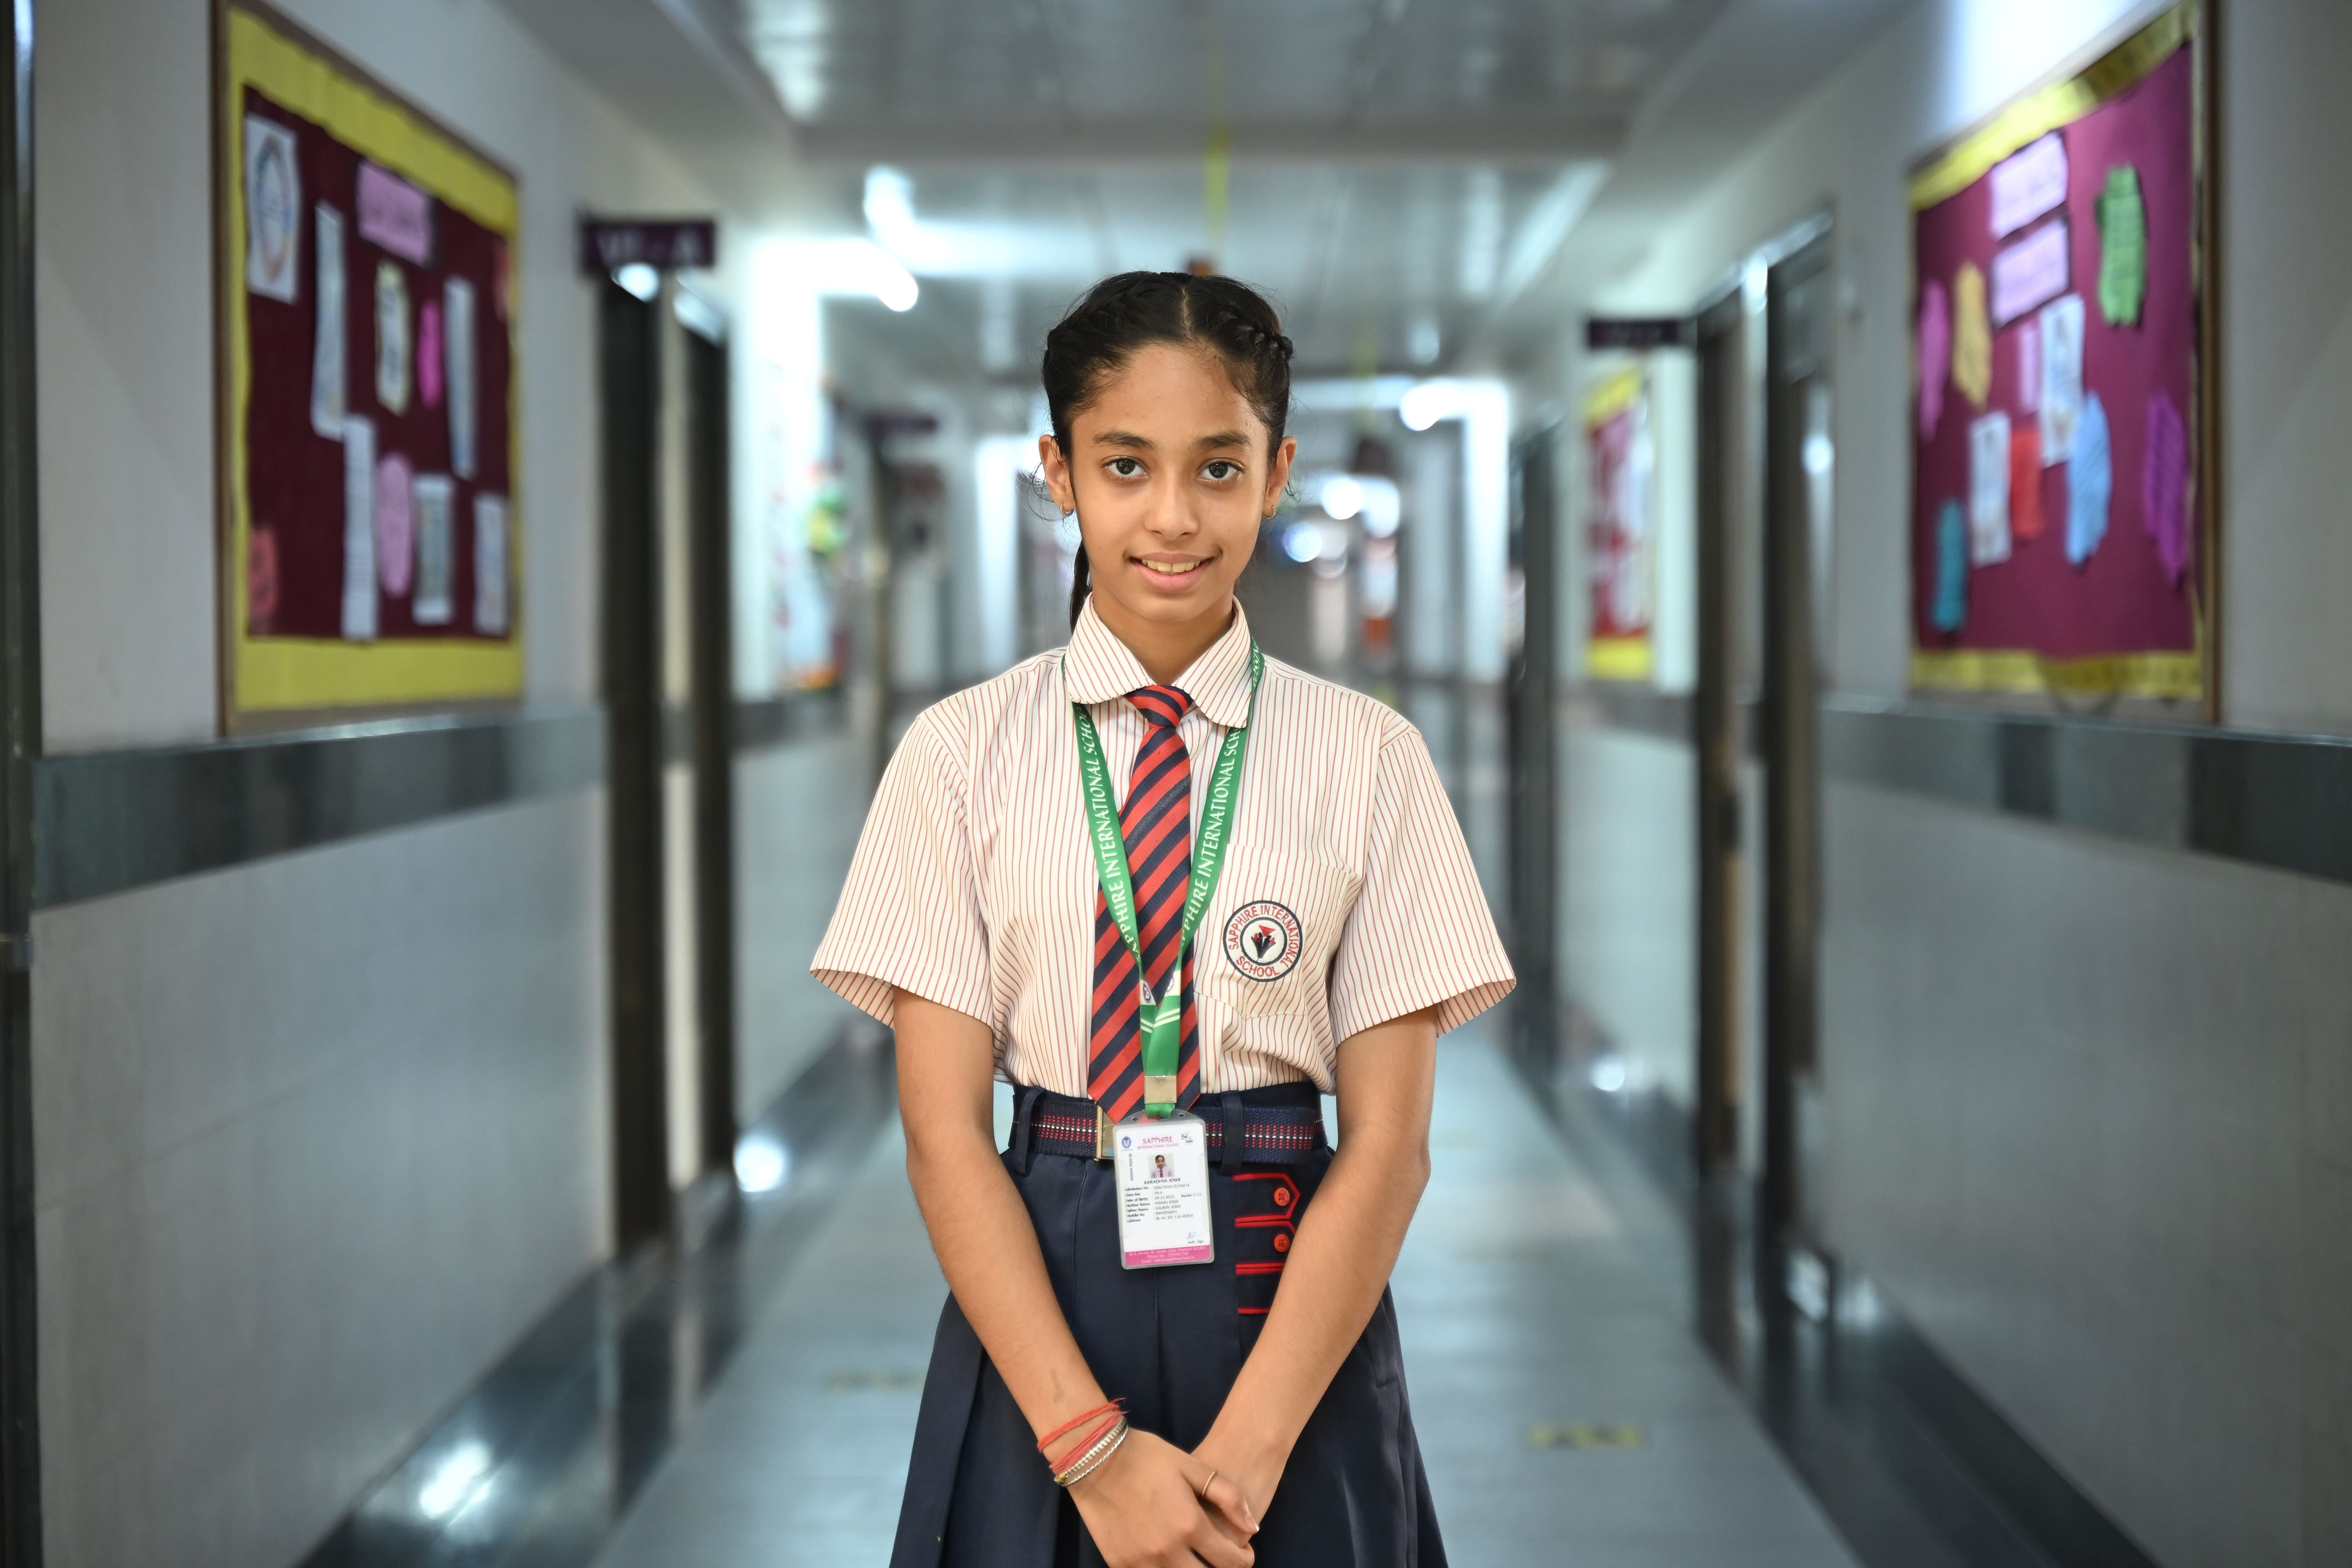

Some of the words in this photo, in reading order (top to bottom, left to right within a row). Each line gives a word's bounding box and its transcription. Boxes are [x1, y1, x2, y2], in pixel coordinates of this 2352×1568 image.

[1086, 758, 1122, 879] INTERNATIONAL
[1201, 758, 1235, 878] INTERNATIONAL
[1228, 906, 1259, 950] SAPPHIRE
[1261, 905, 1300, 968] INTERNATIONAL
[1236, 956, 1280, 977] SCHOOL
[1143, 1136, 1173, 1144] SAPPHIRE
